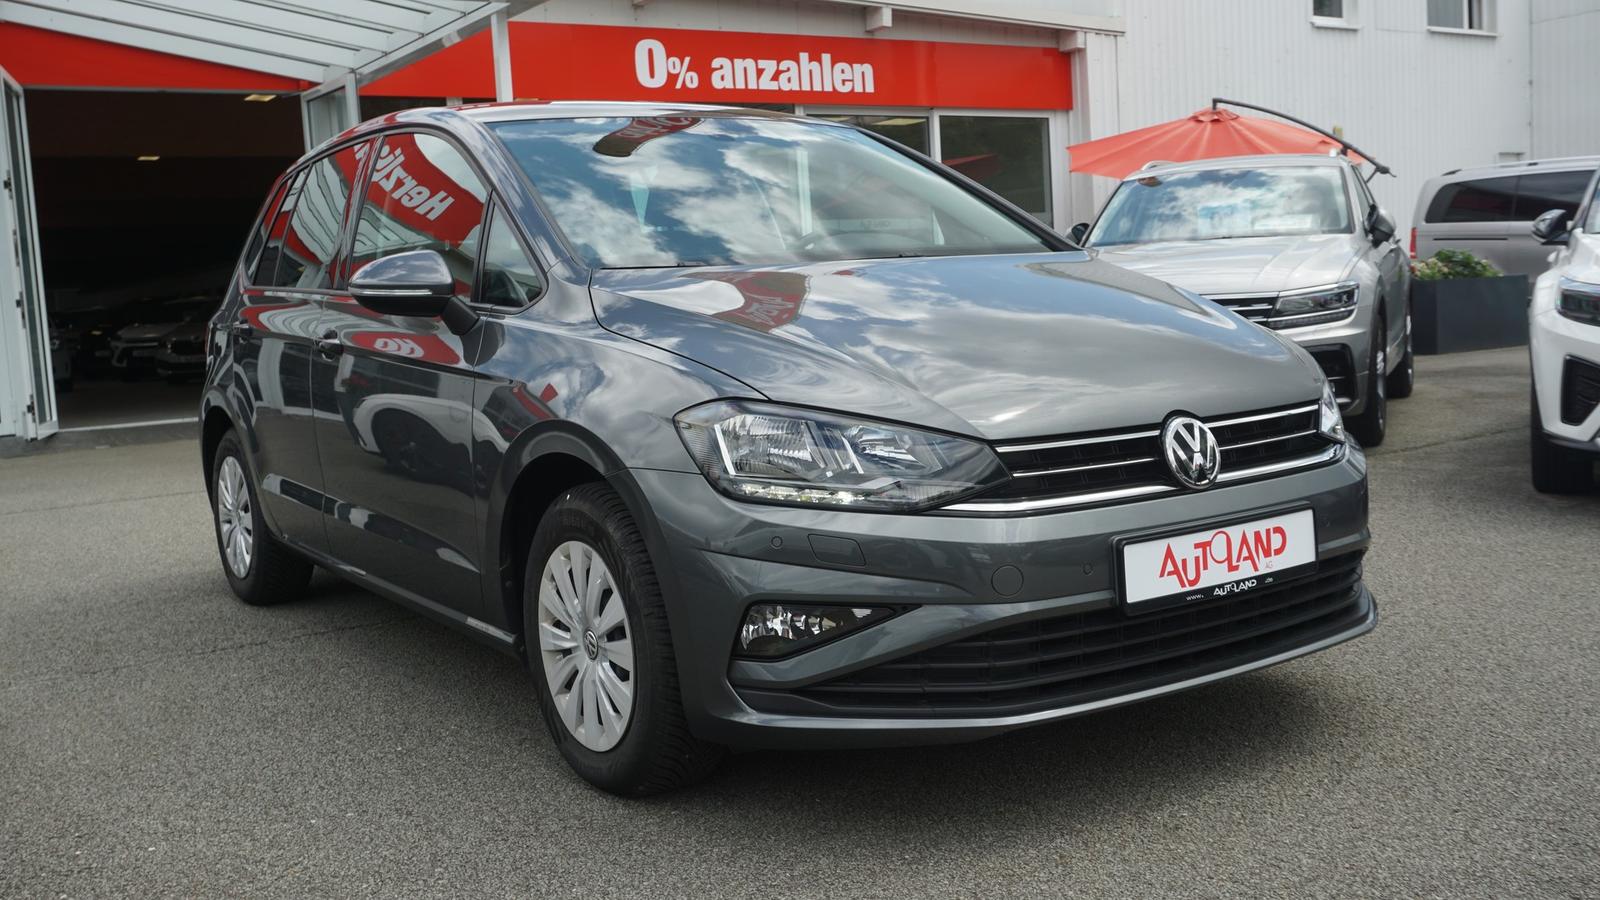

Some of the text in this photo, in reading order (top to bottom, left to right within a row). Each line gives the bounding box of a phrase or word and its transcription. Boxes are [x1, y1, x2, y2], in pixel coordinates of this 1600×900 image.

[635, 38, 875, 93] 0% anzahlen
[1159, 525, 1287, 589] AUTOLAND
[1213, 579, 1257, 596] AUTOLAND
